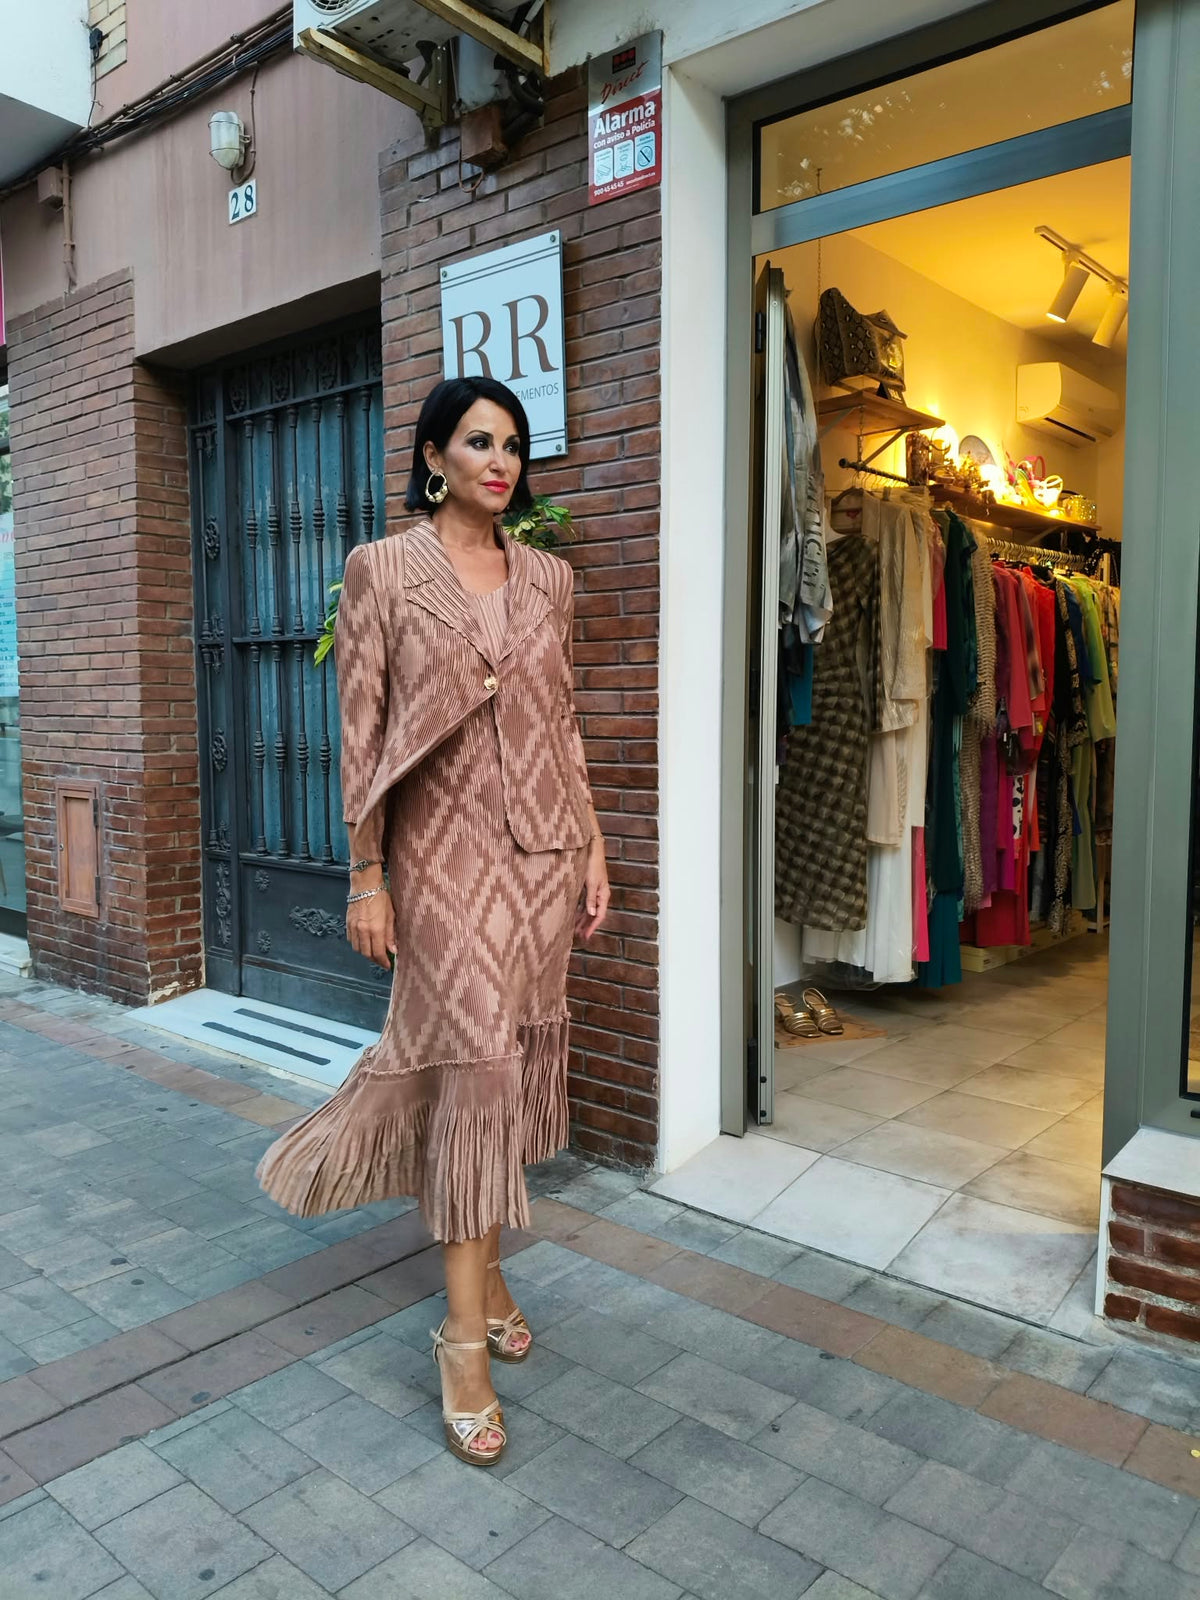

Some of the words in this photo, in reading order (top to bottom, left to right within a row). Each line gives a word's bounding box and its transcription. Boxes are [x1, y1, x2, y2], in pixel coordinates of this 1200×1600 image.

[594, 101, 656, 138] Alarma
[607, 132, 625, 144] aviso
[625, 129, 631, 137] a
[231, 185, 254, 220] 28
[516, 382, 559, 401] EMENTOS
